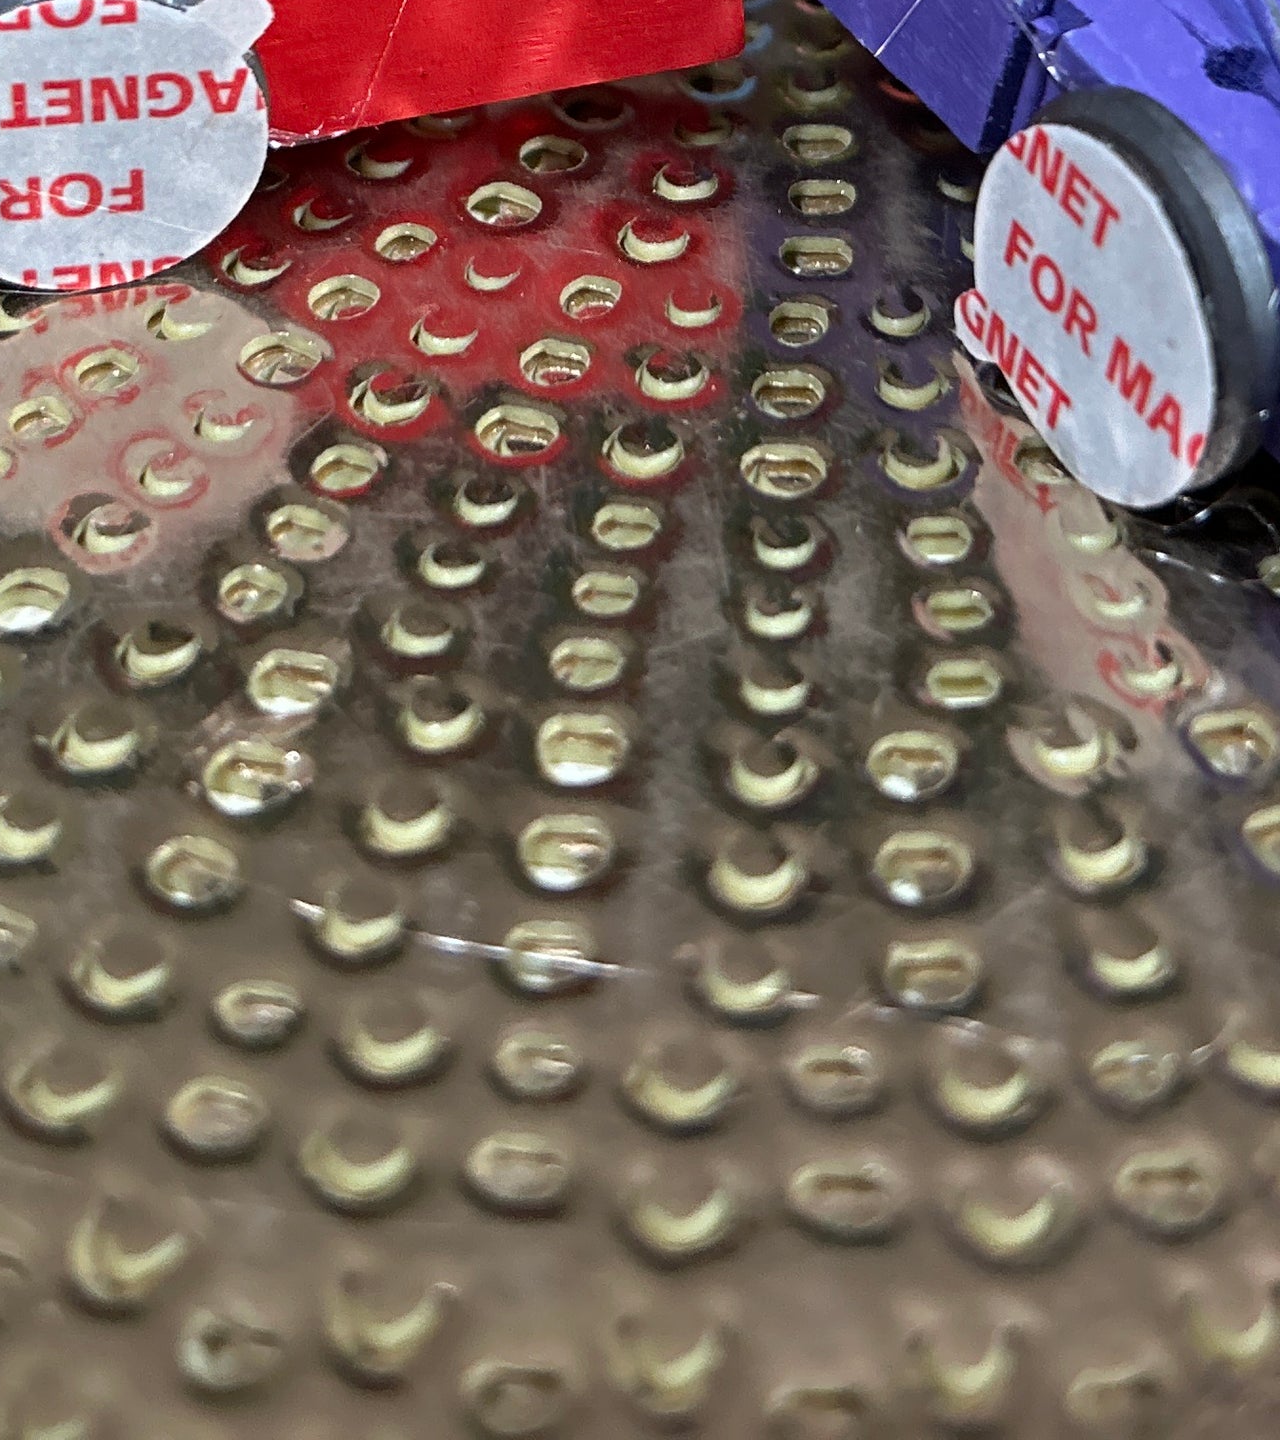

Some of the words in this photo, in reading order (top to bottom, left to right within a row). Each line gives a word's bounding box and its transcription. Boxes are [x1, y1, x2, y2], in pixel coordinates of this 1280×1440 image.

[0, 67, 267, 130] AGNET
[1003, 219, 1099, 357] FOR
[959, 287, 1072, 431] GNET
